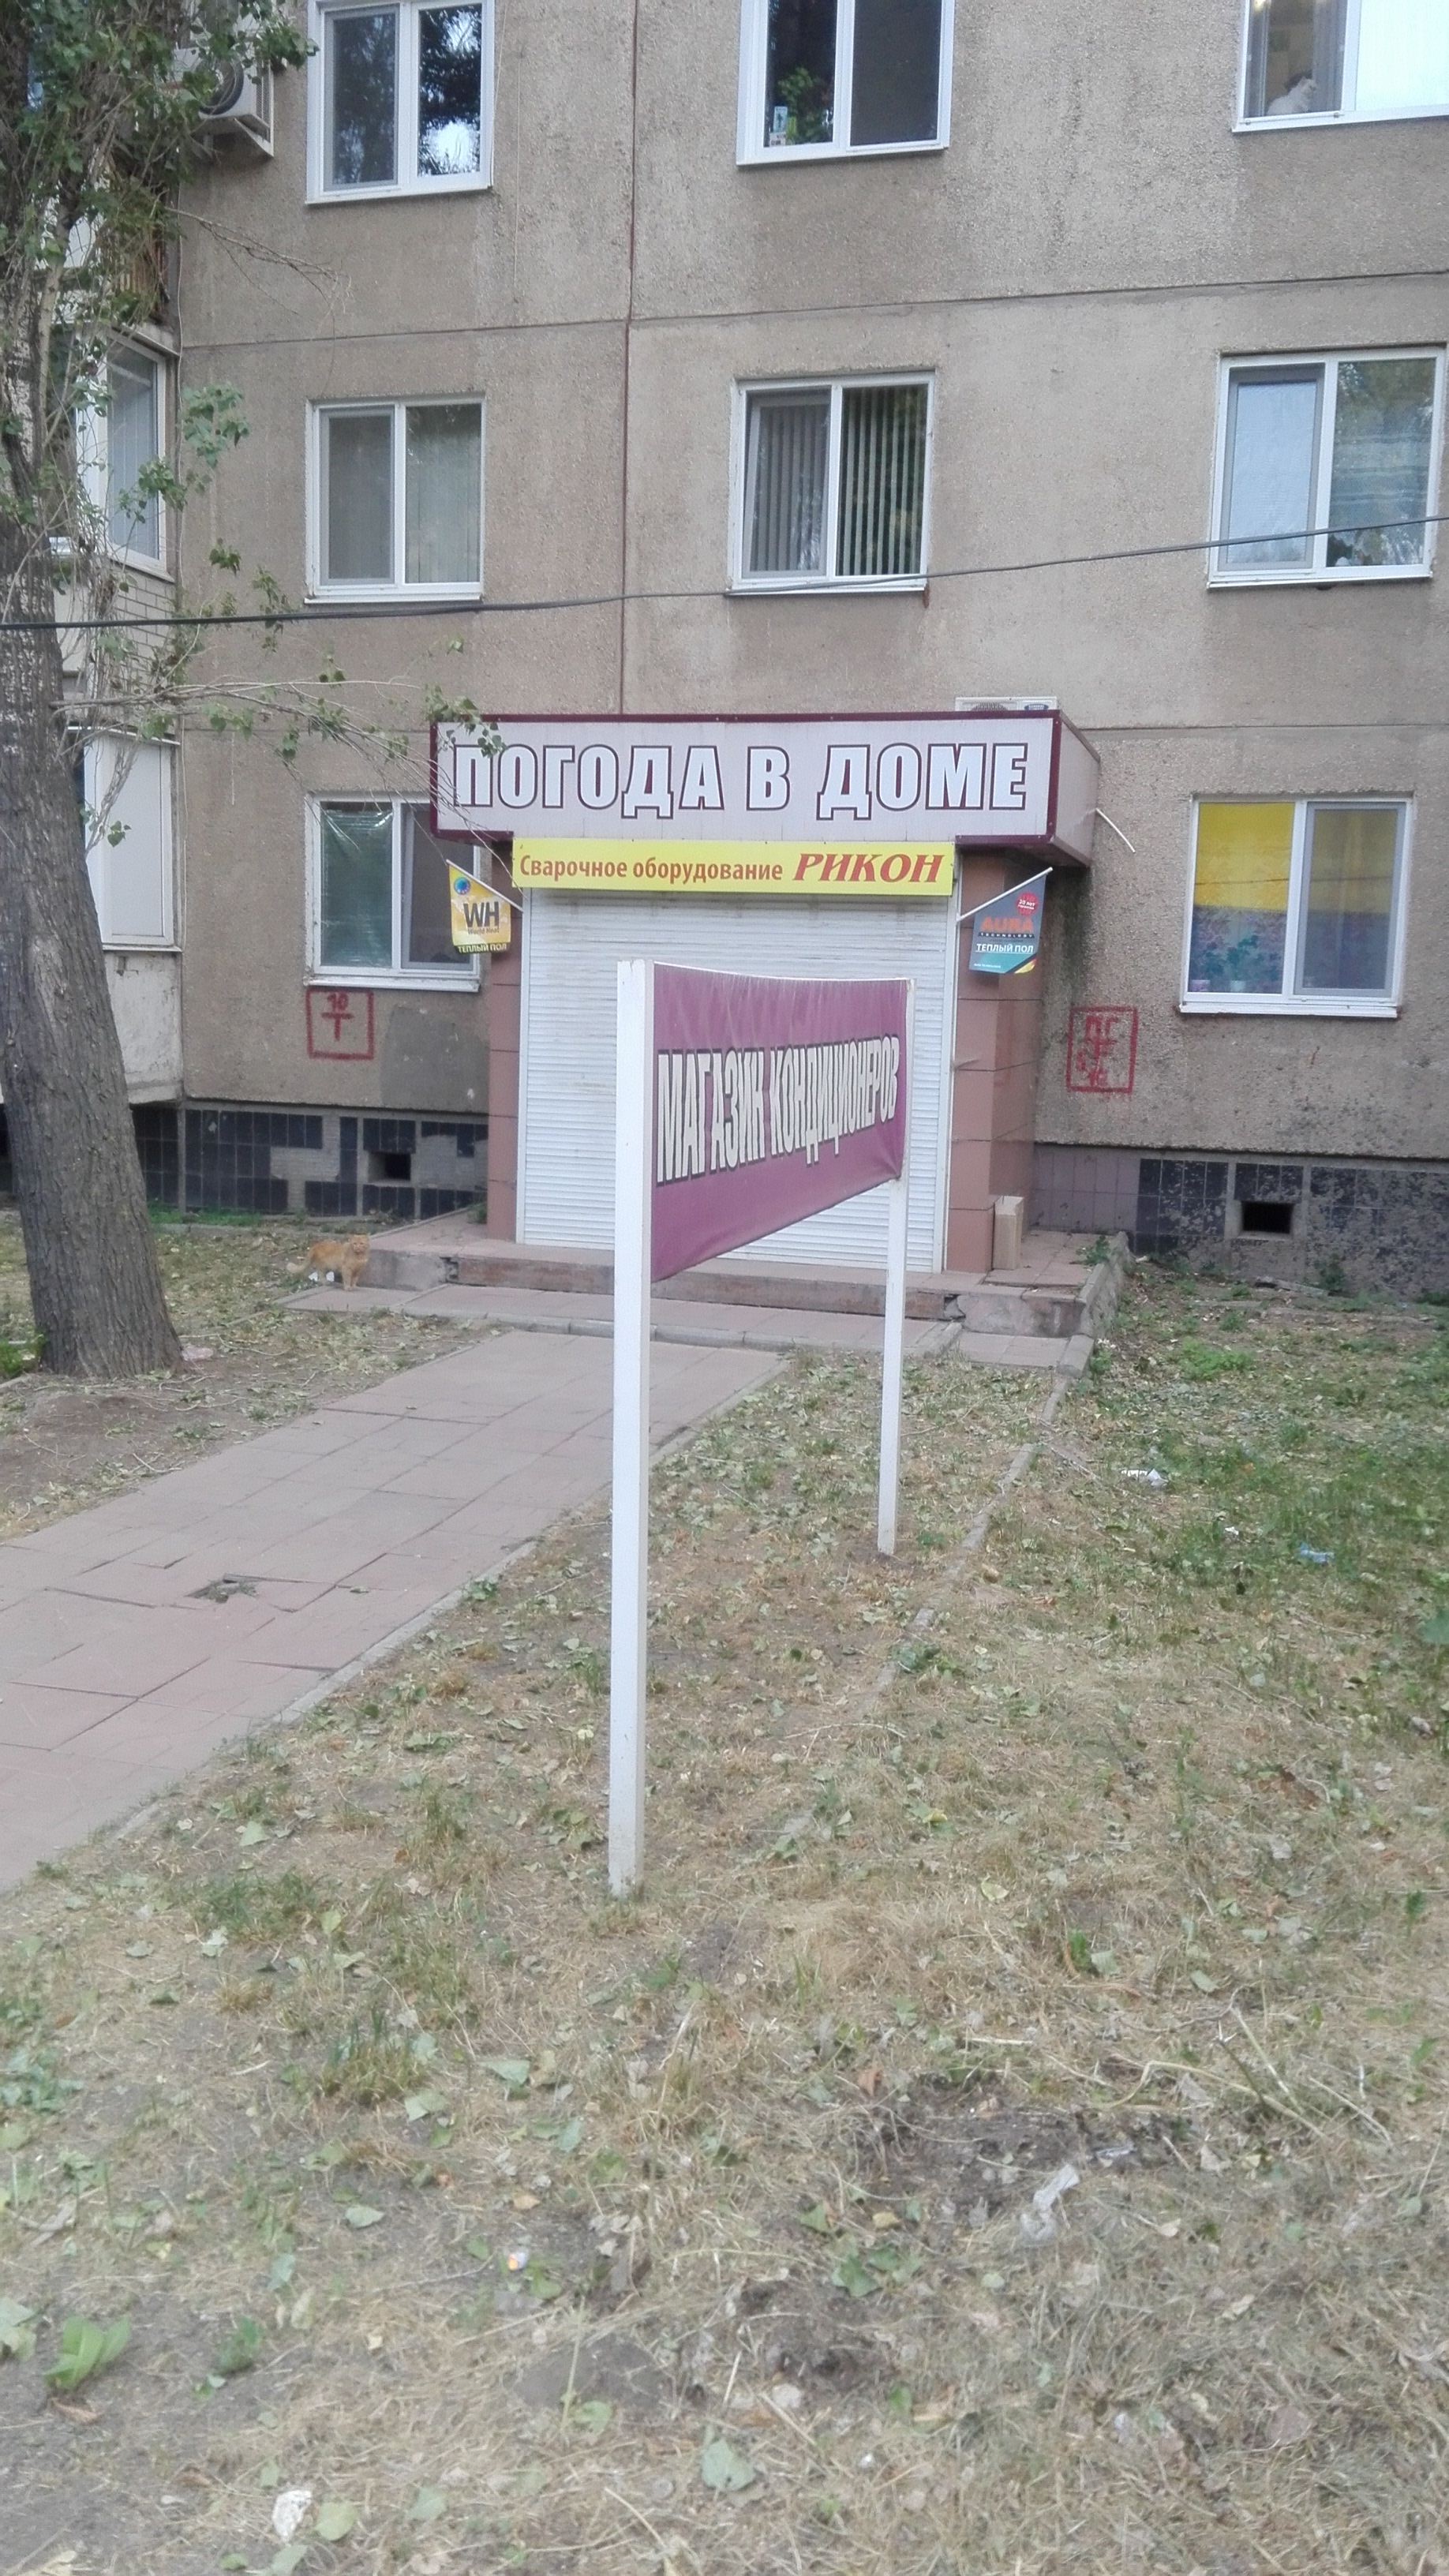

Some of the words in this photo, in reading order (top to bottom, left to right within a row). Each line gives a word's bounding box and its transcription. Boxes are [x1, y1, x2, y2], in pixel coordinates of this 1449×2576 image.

[454, 743, 724, 818] ПОГОДА
[746, 746, 790, 811] В
[816, 743, 1028, 821] ДОМЕ
[520, 855, 627, 882] Сварочное
[633, 857, 783, 884] оборудование
[792, 853, 945, 882] РИКОН
[463, 901, 500, 927] WH
[980, 916, 1034, 932] AURA
[976, 943, 1013, 953] ТЕПЛЫЙ
[1014, 945, 1034, 953] ПОЛ
[656, 1046, 766, 1187] МАГАЗИН
[769, 1032, 900, 1168] КОНДИЦИОНЕРОВ
